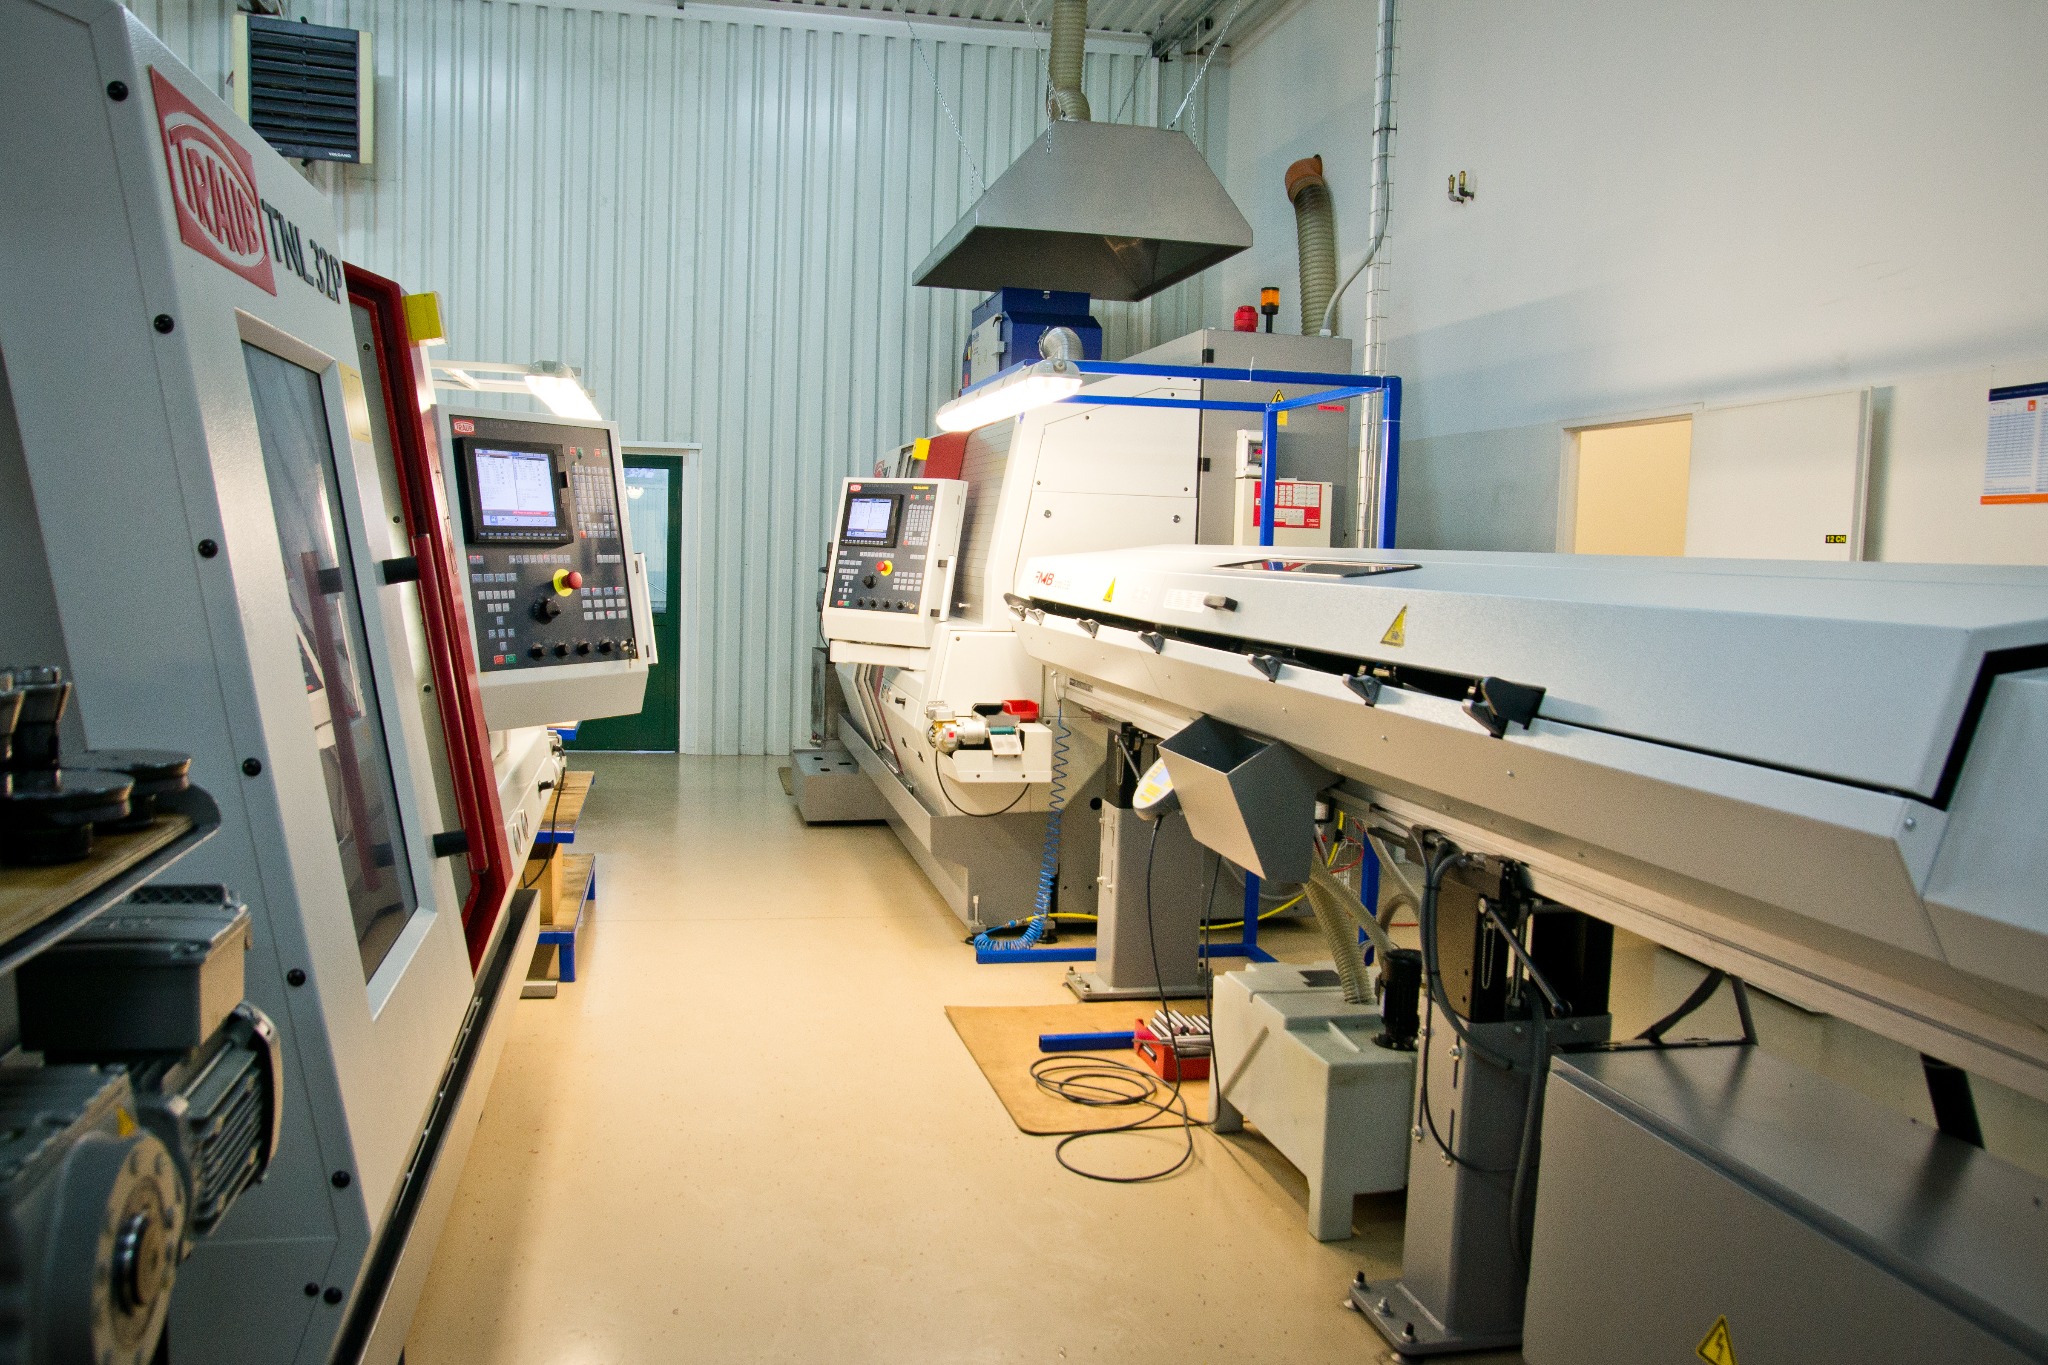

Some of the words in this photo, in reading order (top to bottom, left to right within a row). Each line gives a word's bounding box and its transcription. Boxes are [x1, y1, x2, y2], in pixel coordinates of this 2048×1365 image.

[169, 123, 260, 256] TRAUB
[260, 198, 314, 286] TNL
[310, 239, 343, 304] 32P
[1035, 570, 1055, 586] FMB
